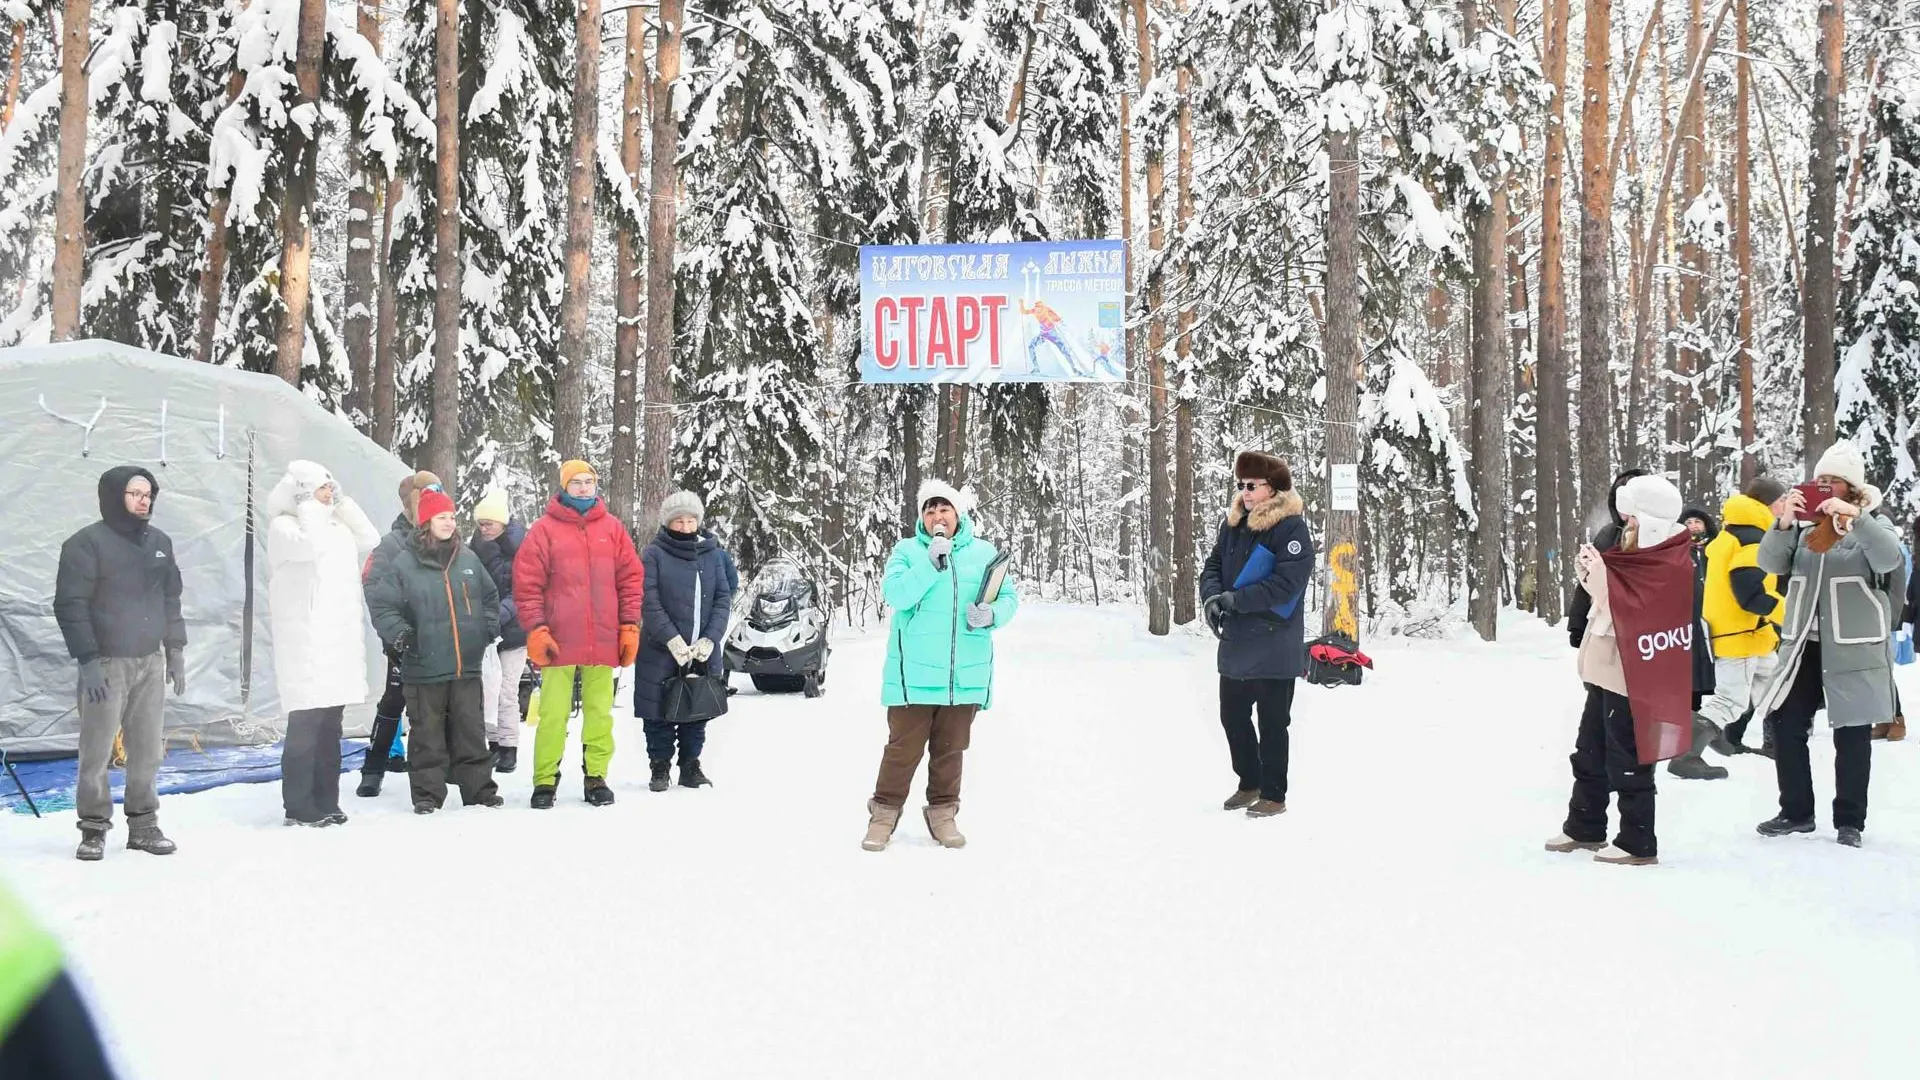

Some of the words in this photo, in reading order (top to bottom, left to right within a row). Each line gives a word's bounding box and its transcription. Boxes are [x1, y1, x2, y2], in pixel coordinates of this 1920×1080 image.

[1044, 250, 1124, 275] ЛЫЖНЯ
[1046, 279, 1081, 293] ТРАССА
[874, 295, 1008, 369] СТАРТ
